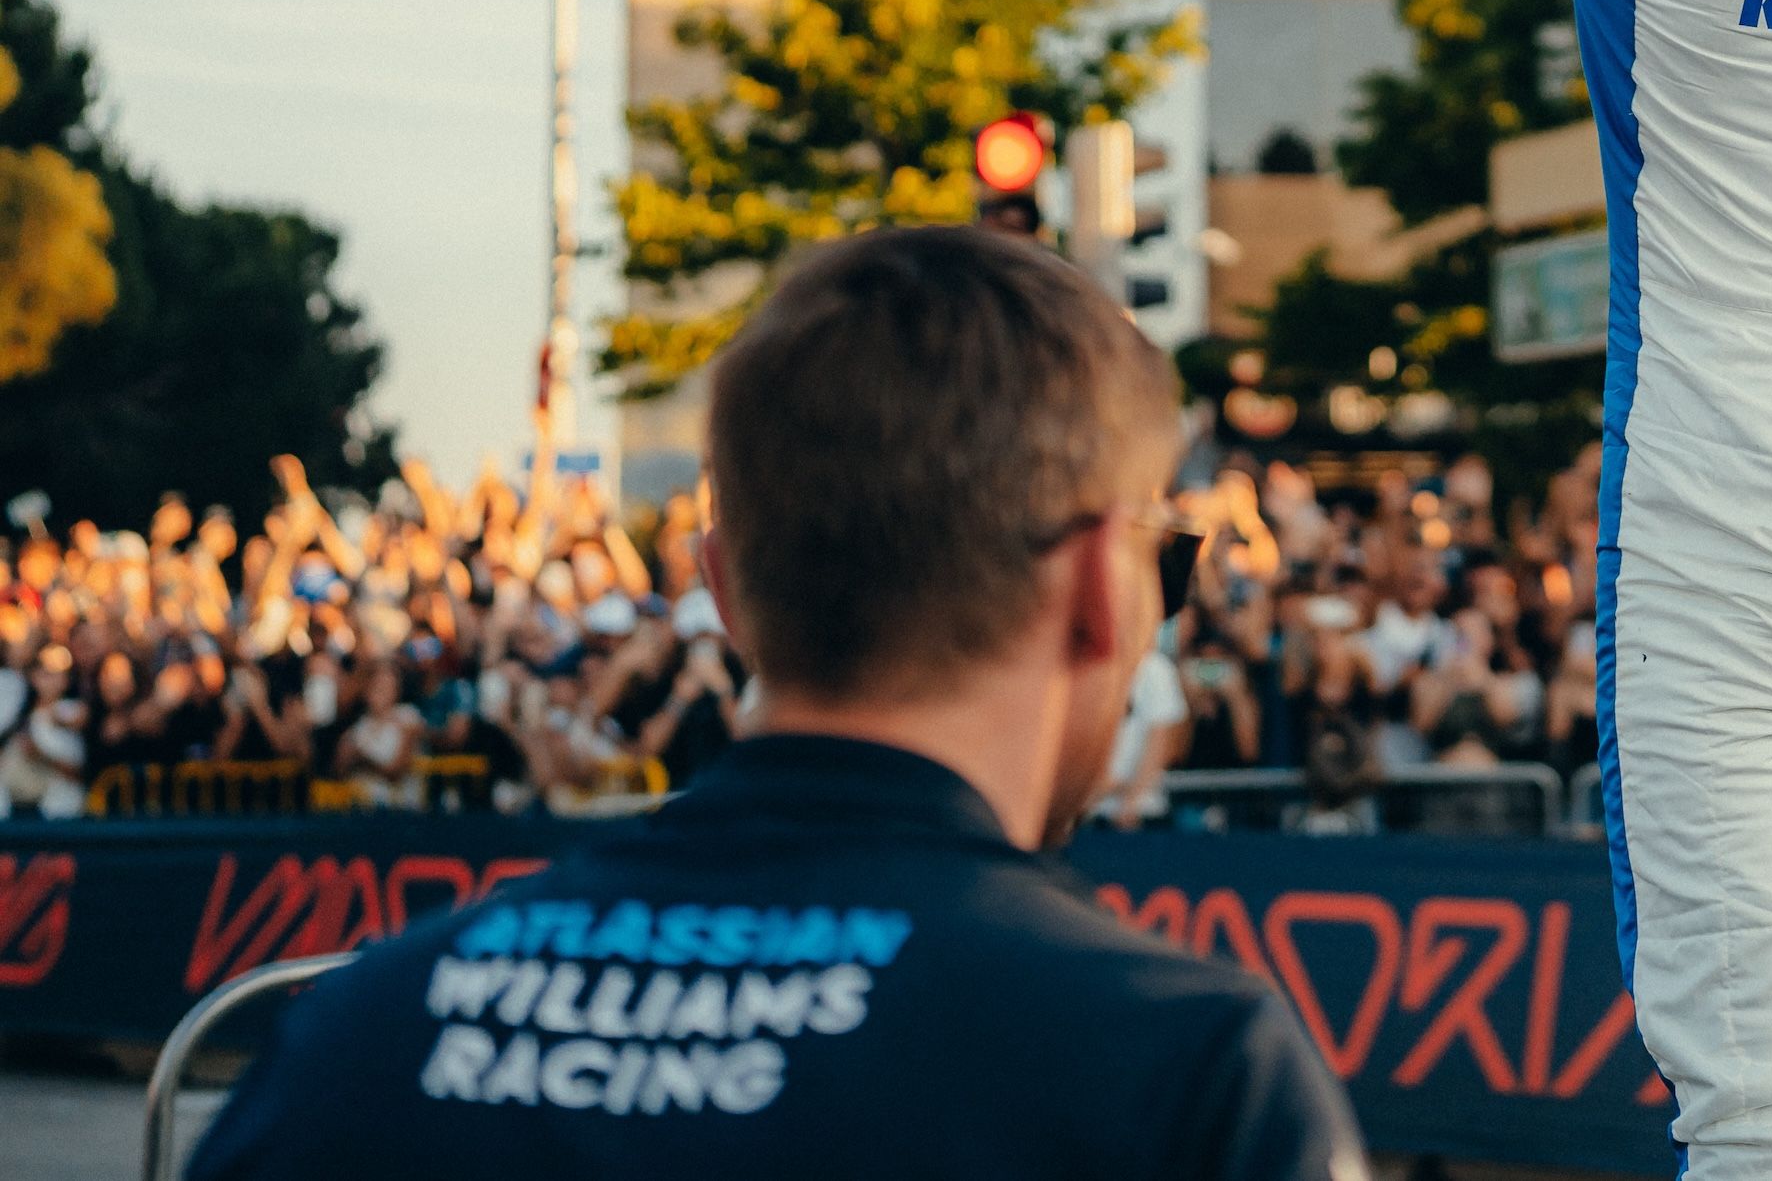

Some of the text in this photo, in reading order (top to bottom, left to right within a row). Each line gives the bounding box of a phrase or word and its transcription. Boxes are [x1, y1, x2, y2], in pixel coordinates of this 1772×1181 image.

[456, 899, 913, 966] ATLASSIAN
[426, 956, 873, 1039] WILLIAMS
[421, 1025, 786, 1115] RACING
